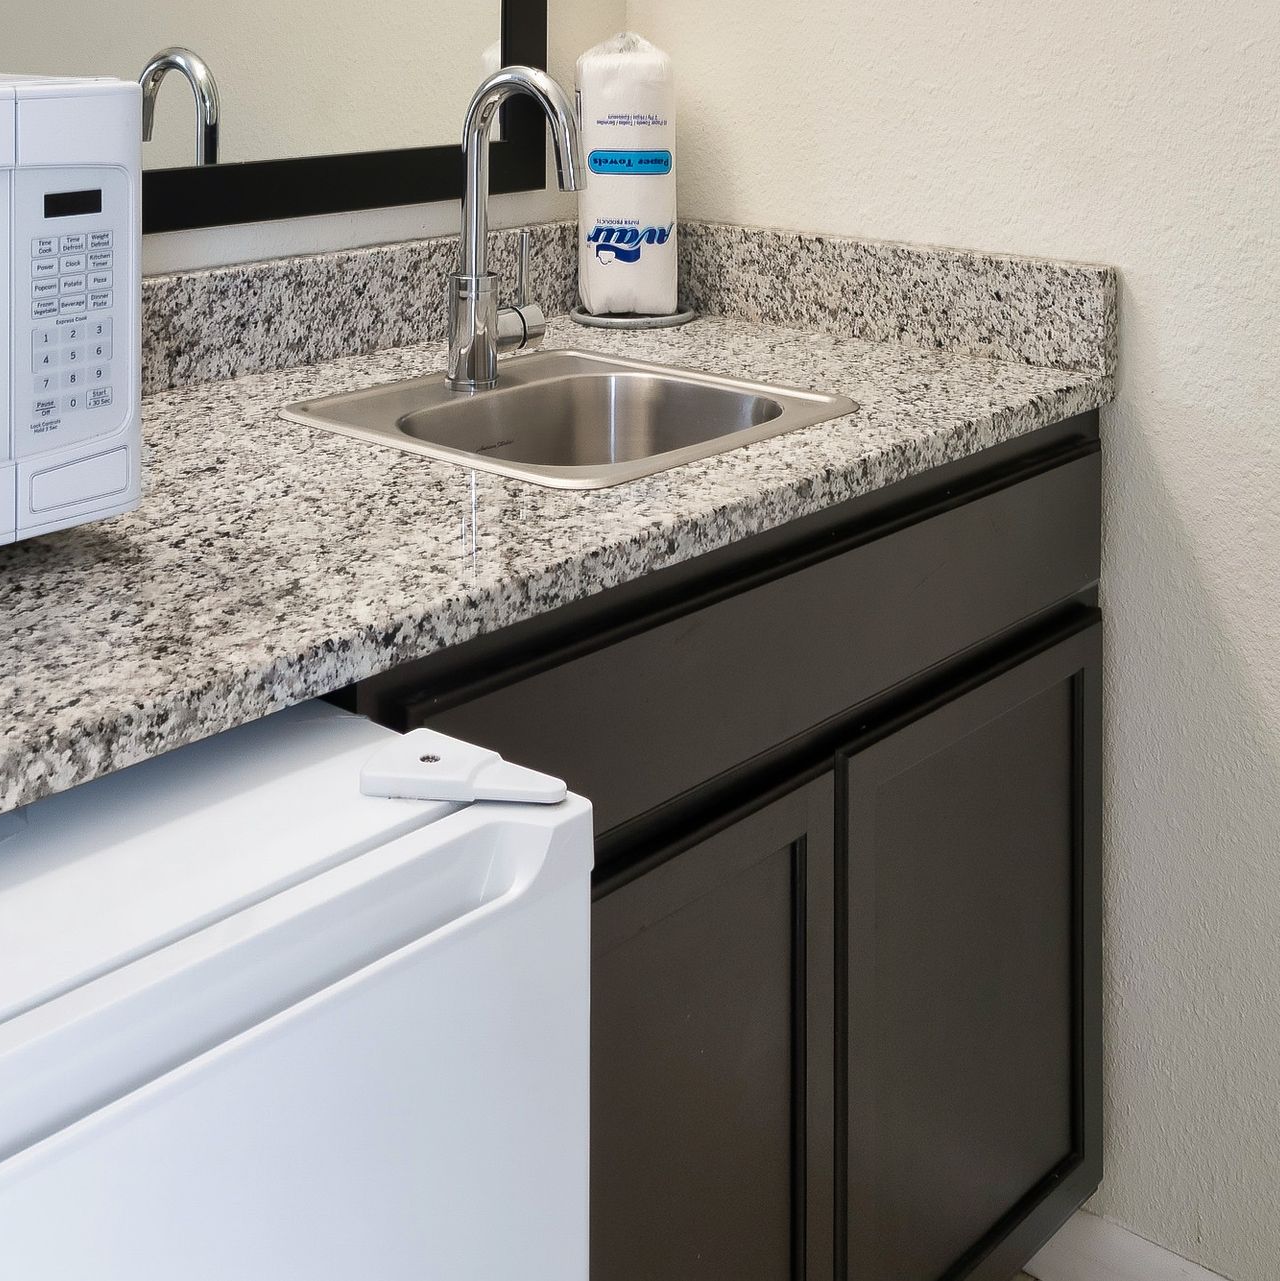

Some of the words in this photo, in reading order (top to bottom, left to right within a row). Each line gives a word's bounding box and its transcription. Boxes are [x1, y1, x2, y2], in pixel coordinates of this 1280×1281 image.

[593, 158, 634, 167] Towels
[638, 158, 669, 167] Paper
[34, 284, 57, 292] Popcorn
[61, 301, 85, 309] Beverage
[33, 308, 58, 316] Vegetable
[70, 330, 76, 338] 2
[96, 325, 102, 334] 3
[44, 334, 48, 343] 1
[70, 351, 76, 360] 5
[96, 347, 102, 355] 6
[43, 355, 49, 364] 4
[70, 374, 76, 383] 8
[96, 370, 102, 378] 9
[43, 379, 49, 388] 7
[92, 389, 107, 398] Start
[70, 399, 76, 408] 0
